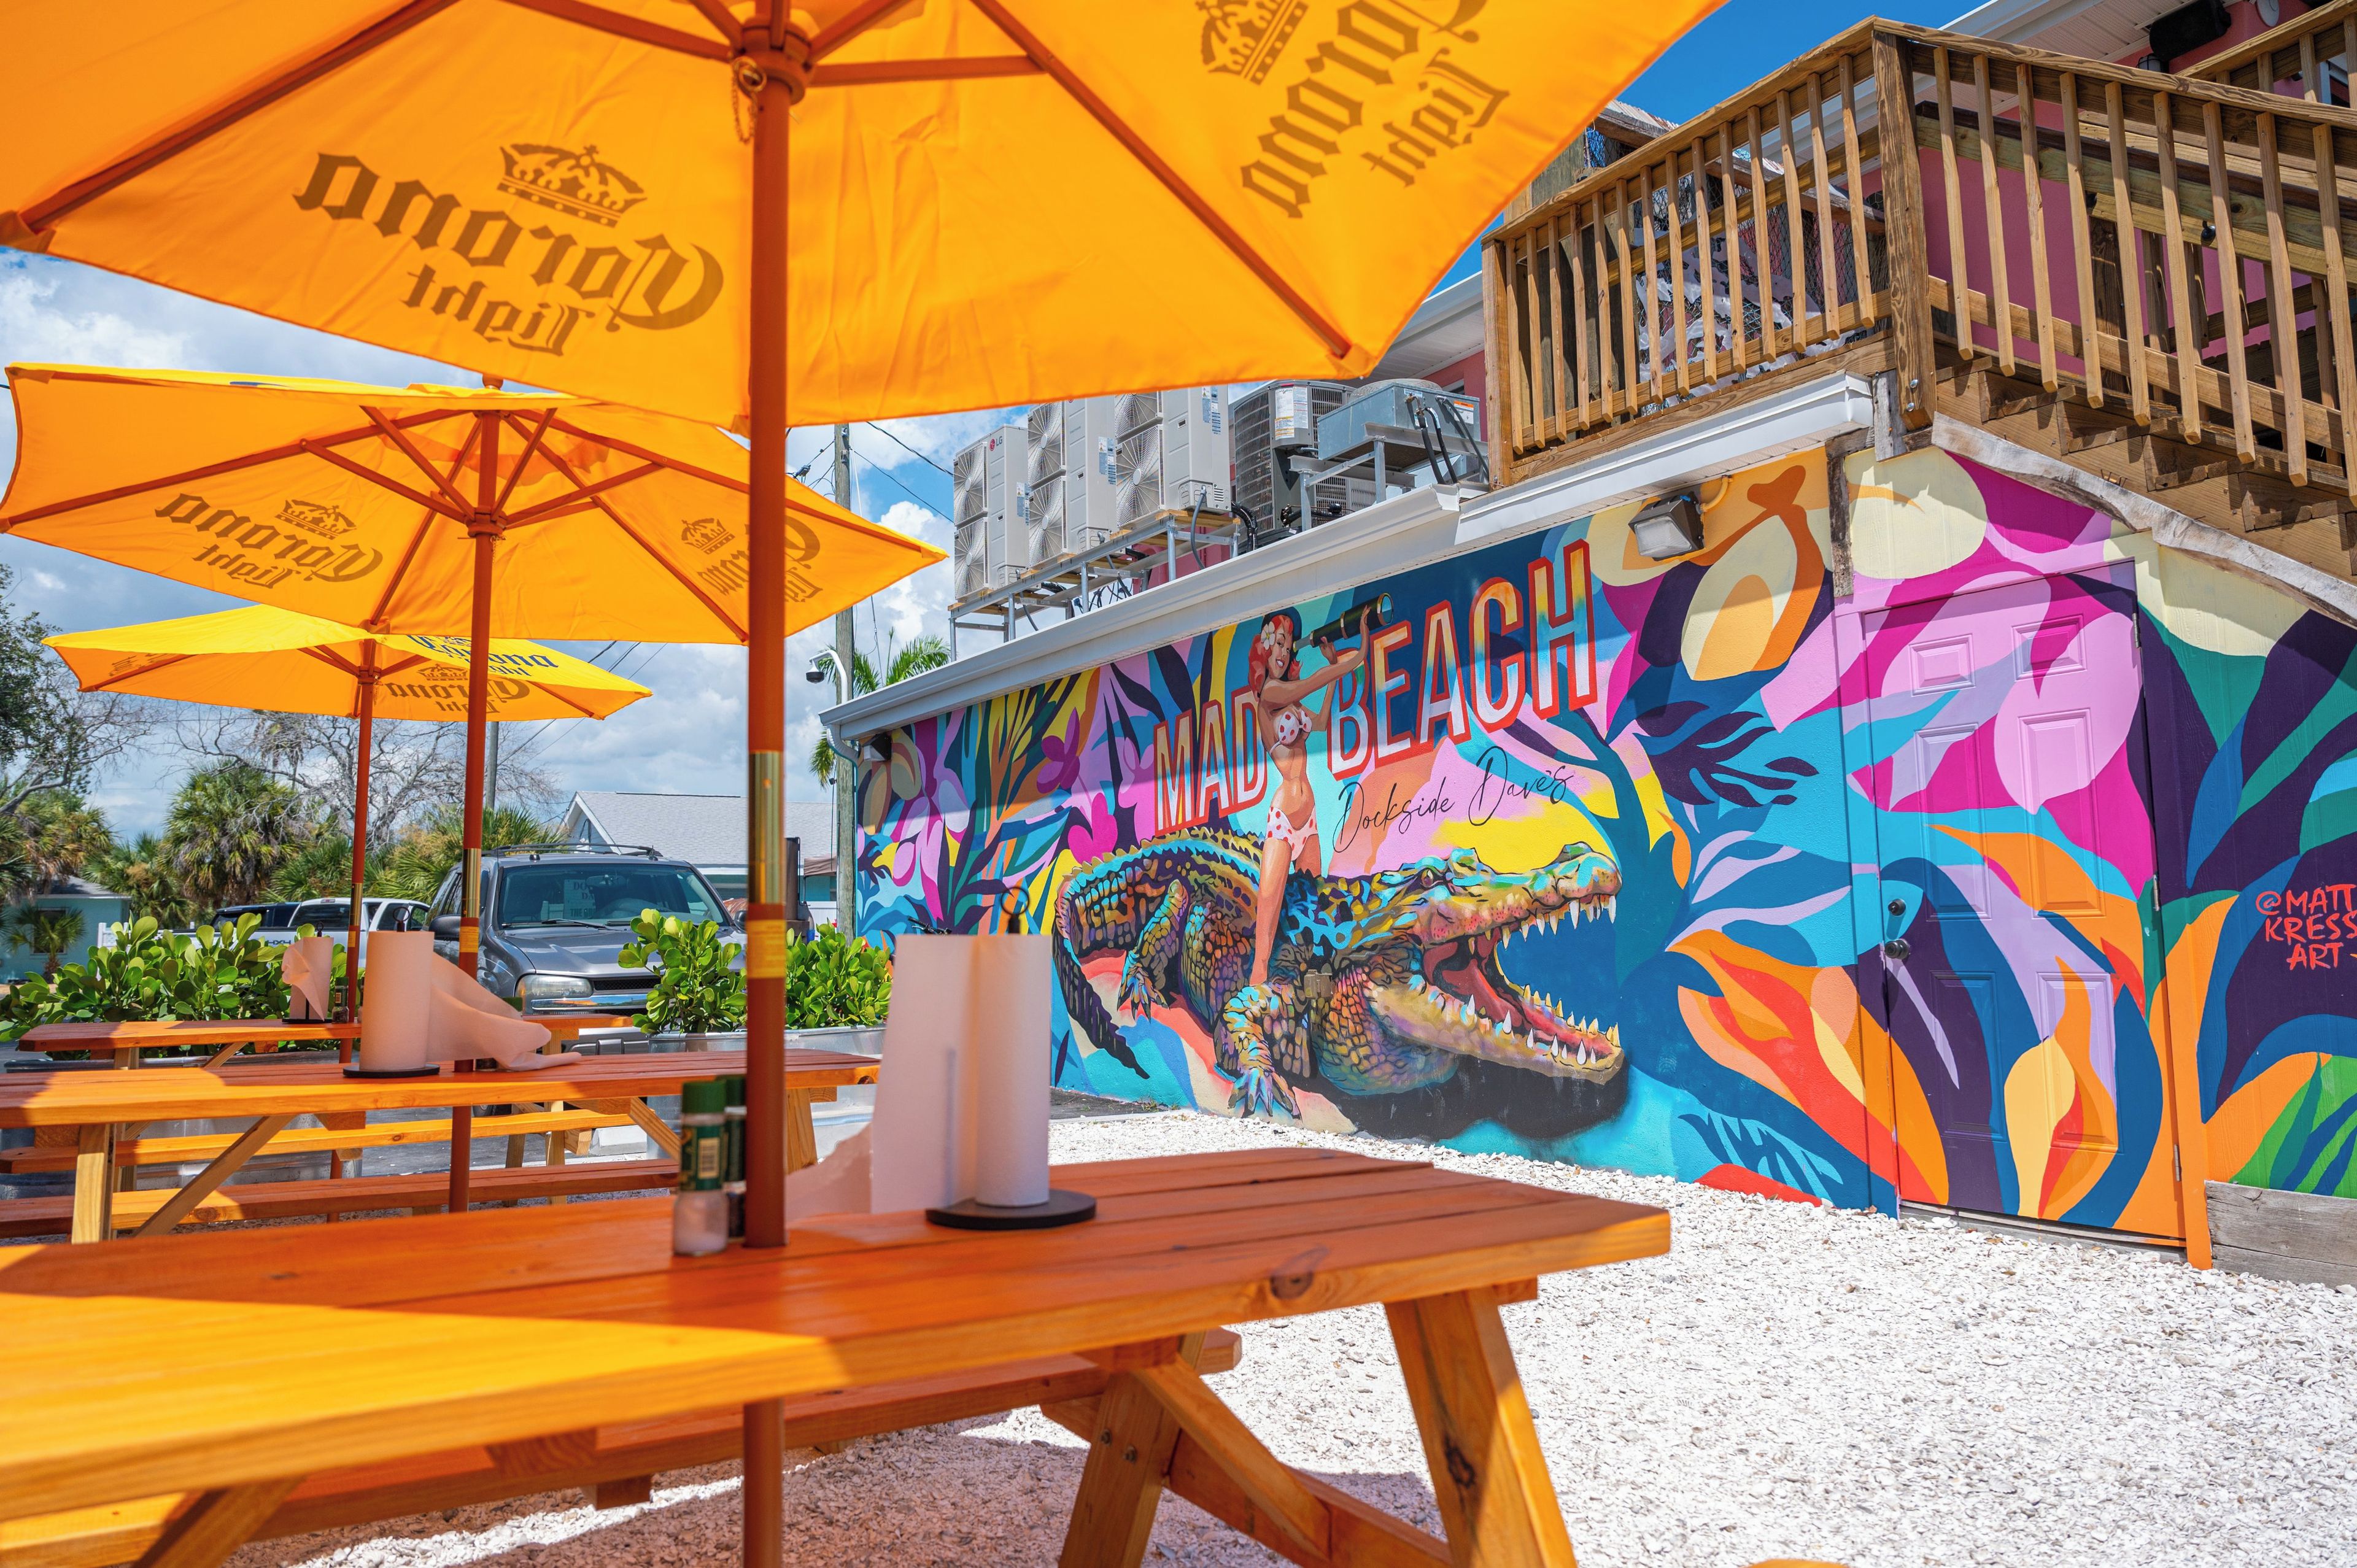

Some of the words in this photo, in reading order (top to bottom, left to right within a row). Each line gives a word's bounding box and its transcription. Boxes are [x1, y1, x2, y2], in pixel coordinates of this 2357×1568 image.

[1153, 684, 1268, 838] MAD
[1327, 538, 1598, 782] BEACH
[1332, 776, 1456, 853] Dockside
[1468, 746, 1575, 826] Dave's
[2255, 884, 2357, 916] @MATT
[2266, 910, 2357, 946] KRESS
[2286, 942, 2343, 970] ART
